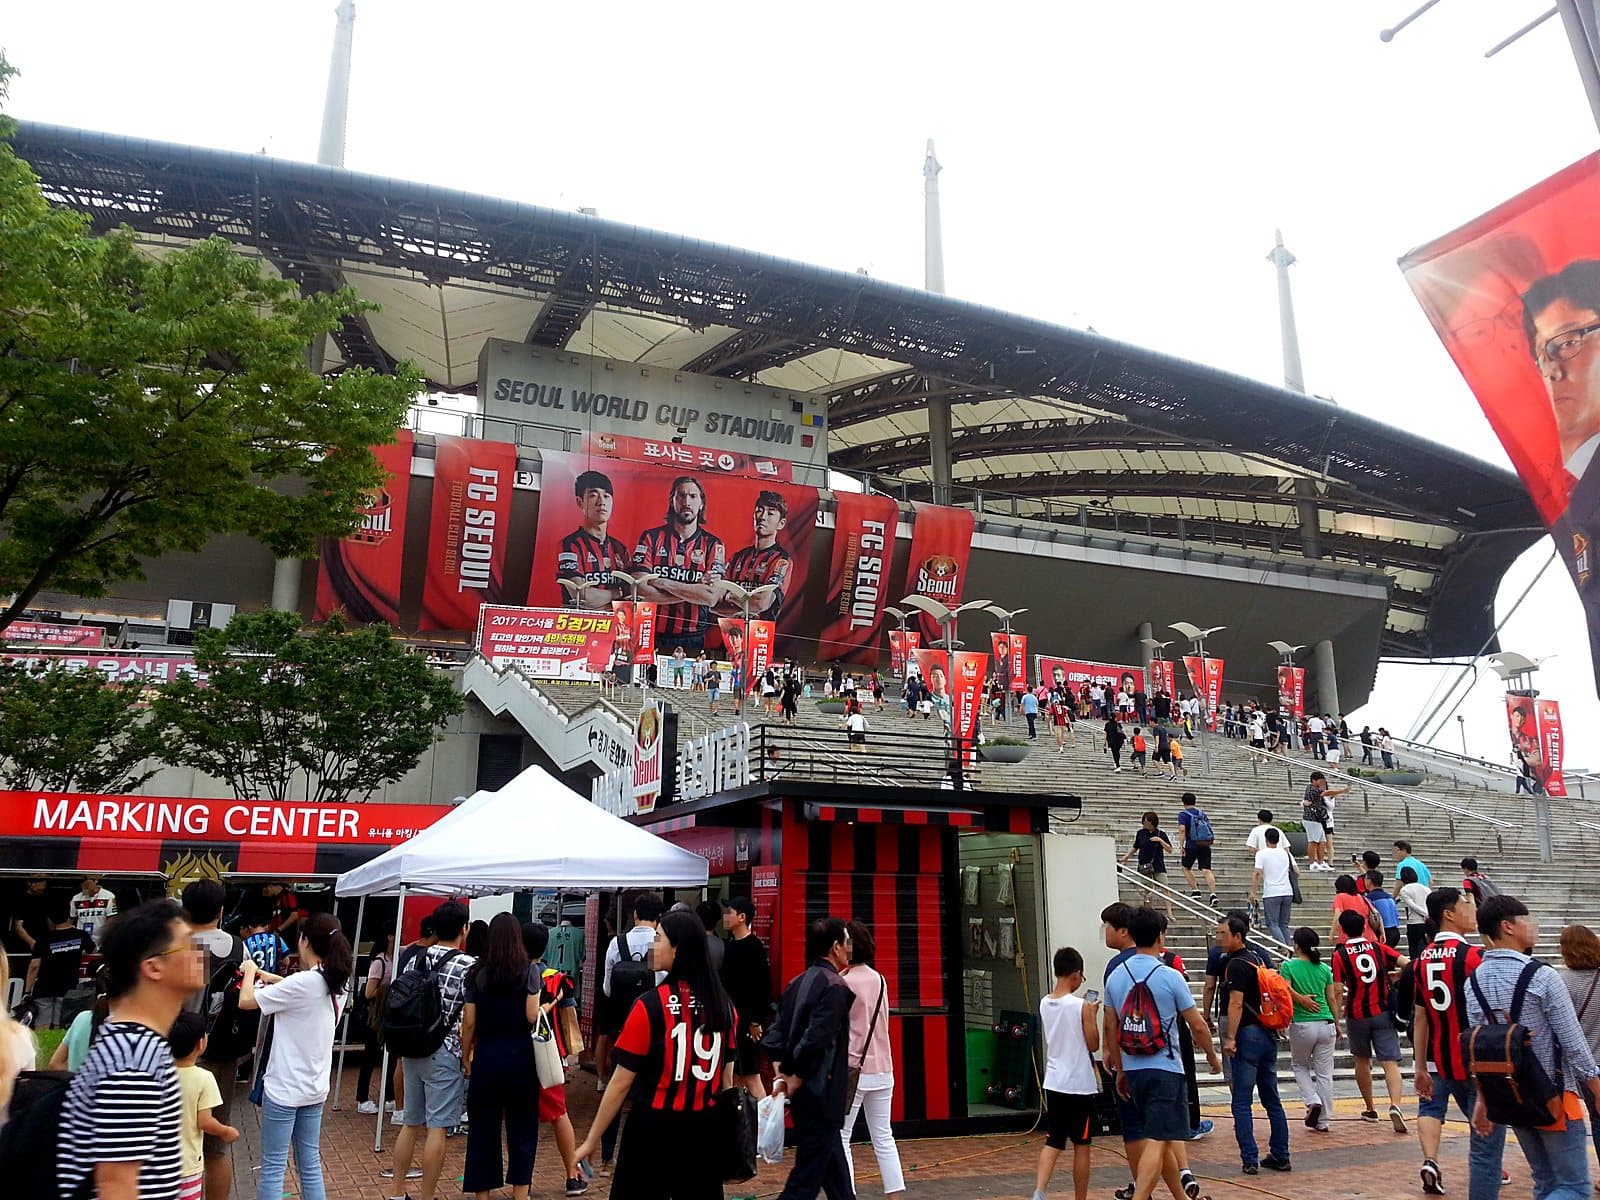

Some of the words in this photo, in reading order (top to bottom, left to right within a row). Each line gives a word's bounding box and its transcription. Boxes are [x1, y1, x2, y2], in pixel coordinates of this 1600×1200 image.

[494, 378, 564, 410] SEOUL
[571, 389, 649, 422] WORLD
[655, 403, 700, 429] CUP
[704, 412, 795, 445] STADIUM
[643, 442, 693, 464] 표사는
[698, 451, 715, 468] 곳
[467, 466, 499, 502] FC
[458, 507, 496, 593] SEOUL
[860, 519, 885, 551] FC
[849, 555, 882, 631] SEOUL
[916, 567, 957, 596] Seoul
[491, 615, 518, 626] 2017
[519, 617, 555, 630] FC서울
[555, 613, 612, 633] 5경기권
[633, 743, 660, 788] Seoul
[33, 798, 210, 835] MARKING
[223, 804, 361, 838] CENTER
[252, 946, 274, 969] 31
[557, 943, 565, 964] 1
[1345, 943, 1374, 955] DEJAN
[1420, 947, 1457, 961] OSMAR
[1355, 953, 1377, 984] 9
[1425, 962, 1452, 1011] 5
[671, 1022, 722, 1082] 19
